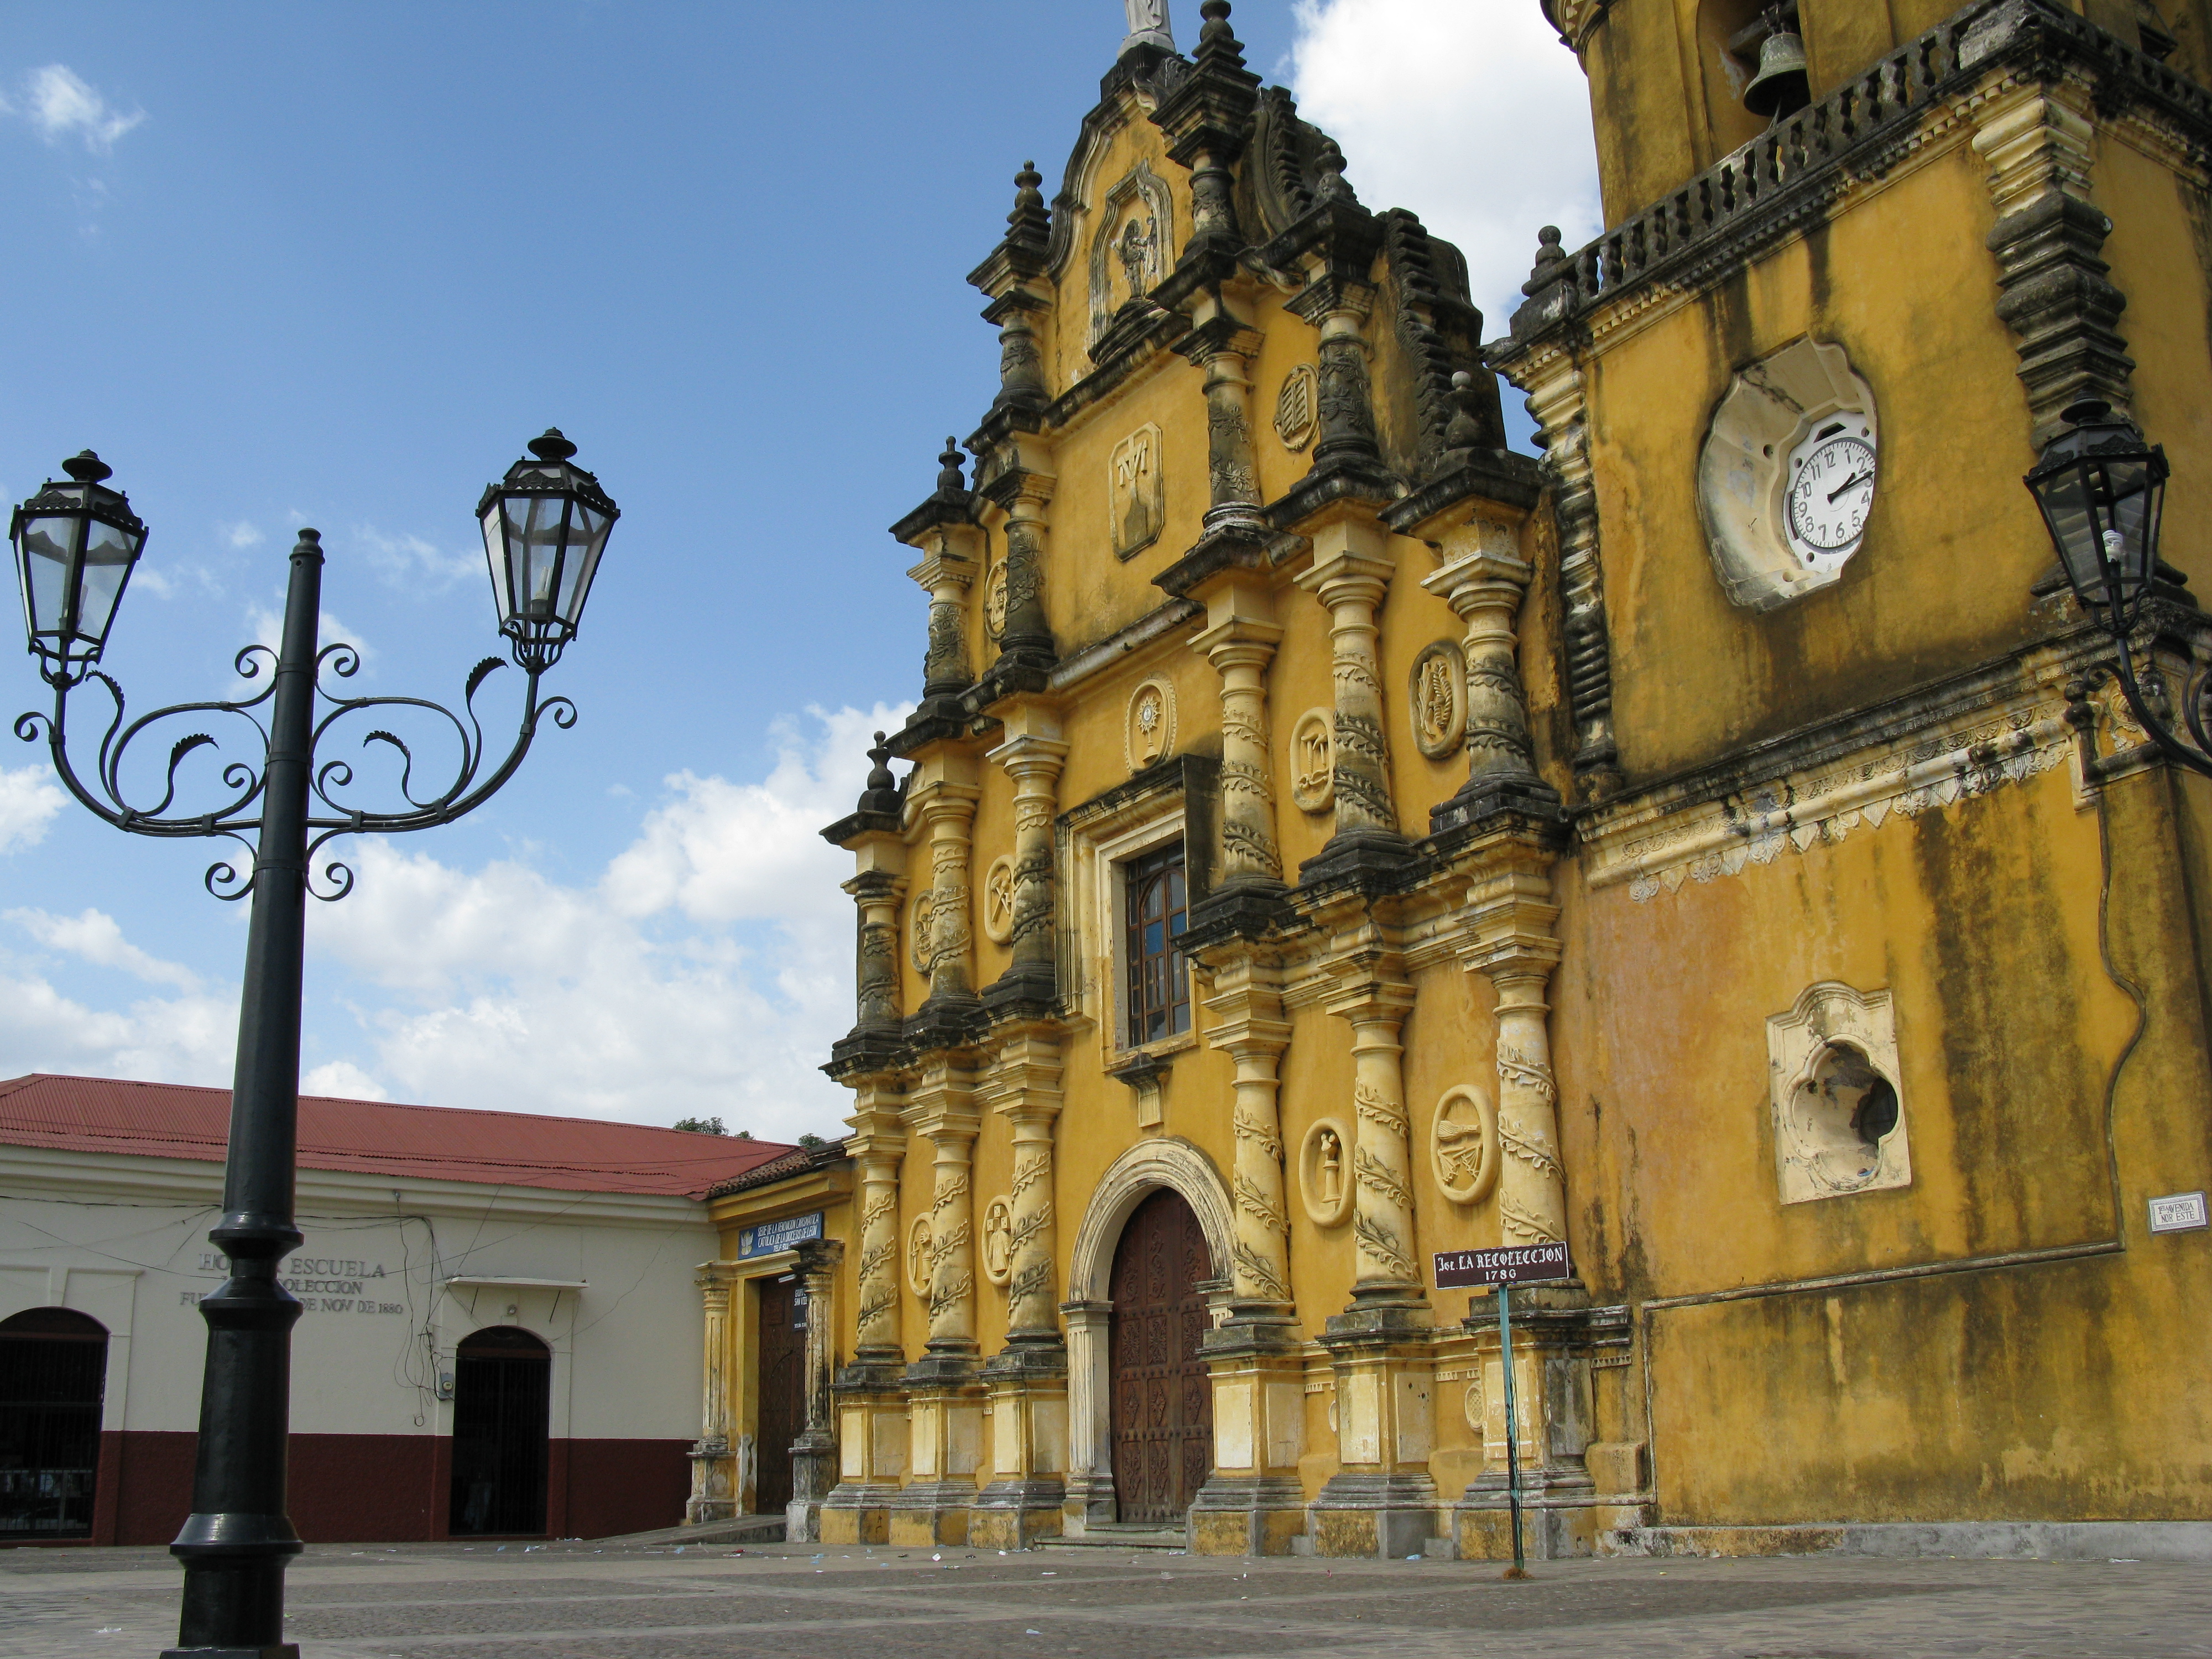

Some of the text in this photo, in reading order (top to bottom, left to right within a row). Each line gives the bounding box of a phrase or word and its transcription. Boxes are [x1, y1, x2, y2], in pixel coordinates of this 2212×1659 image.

[1824, 451, 1836, 469] 12
[1845, 448, 1851, 465] 1
[1856, 456, 1867, 474] 2
[1811, 463, 1821, 481] 11
[1802, 481, 1812, 499] 10
[1861, 490, 1870, 506] 4
[1798, 501, 1808, 518] 9
[1804, 516, 1814, 533] 8
[1851, 509, 1860, 528] 5
[1818, 524, 1827, 541] 7
[1835, 521, 1845, 539] 6
[2166, 1202, 2194, 1213] AVENIDA
[2161, 1211, 2195, 1223] NOR ESTE
[772, 1223, 777, 1234] LA
[775, 1233, 781, 1245] DE
[780, 1232, 785, 1243] LA
[801, 1227, 807, 1239] DE
[1458, 1254, 1474, 1270] LA
[1476, 1246, 1563, 1269] RECOLECCION
[290, 1258, 386, 1278] ESCUELA
[1485, 1269, 1516, 1281] 1786
[320, 1298, 354, 1312] NOV
[357, 1300, 375, 1313] DE
